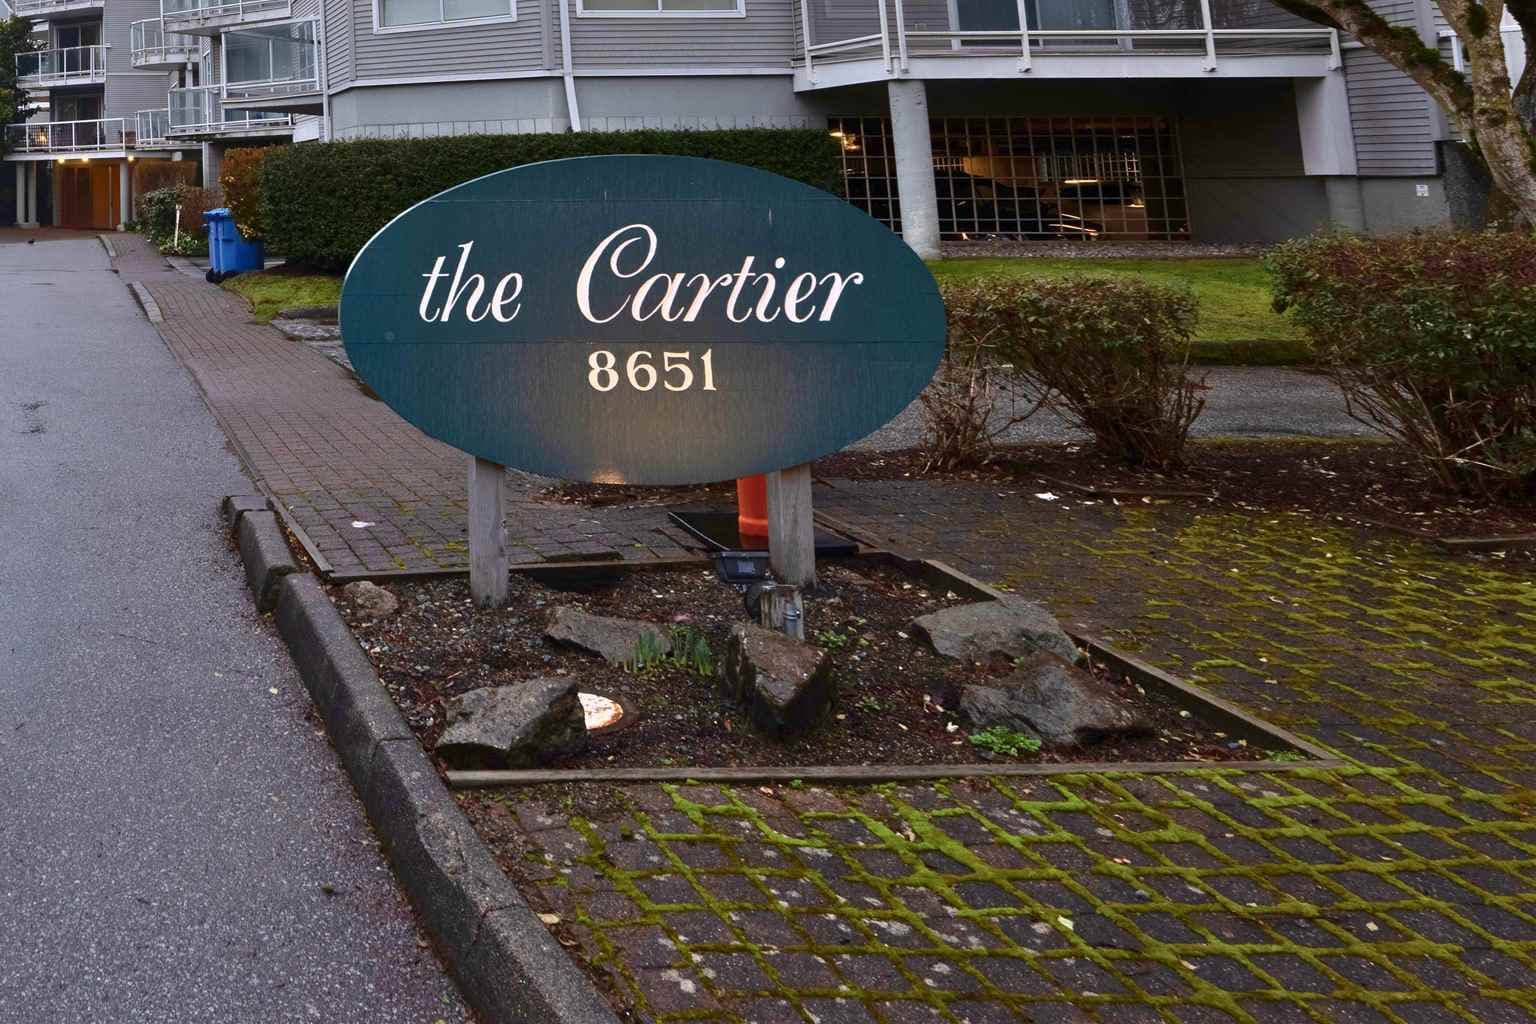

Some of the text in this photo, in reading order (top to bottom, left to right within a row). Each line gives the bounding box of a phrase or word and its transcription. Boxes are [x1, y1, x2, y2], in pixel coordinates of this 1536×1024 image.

[420, 223, 864, 324] the Cartier
[589, 349, 717, 392] 8651
